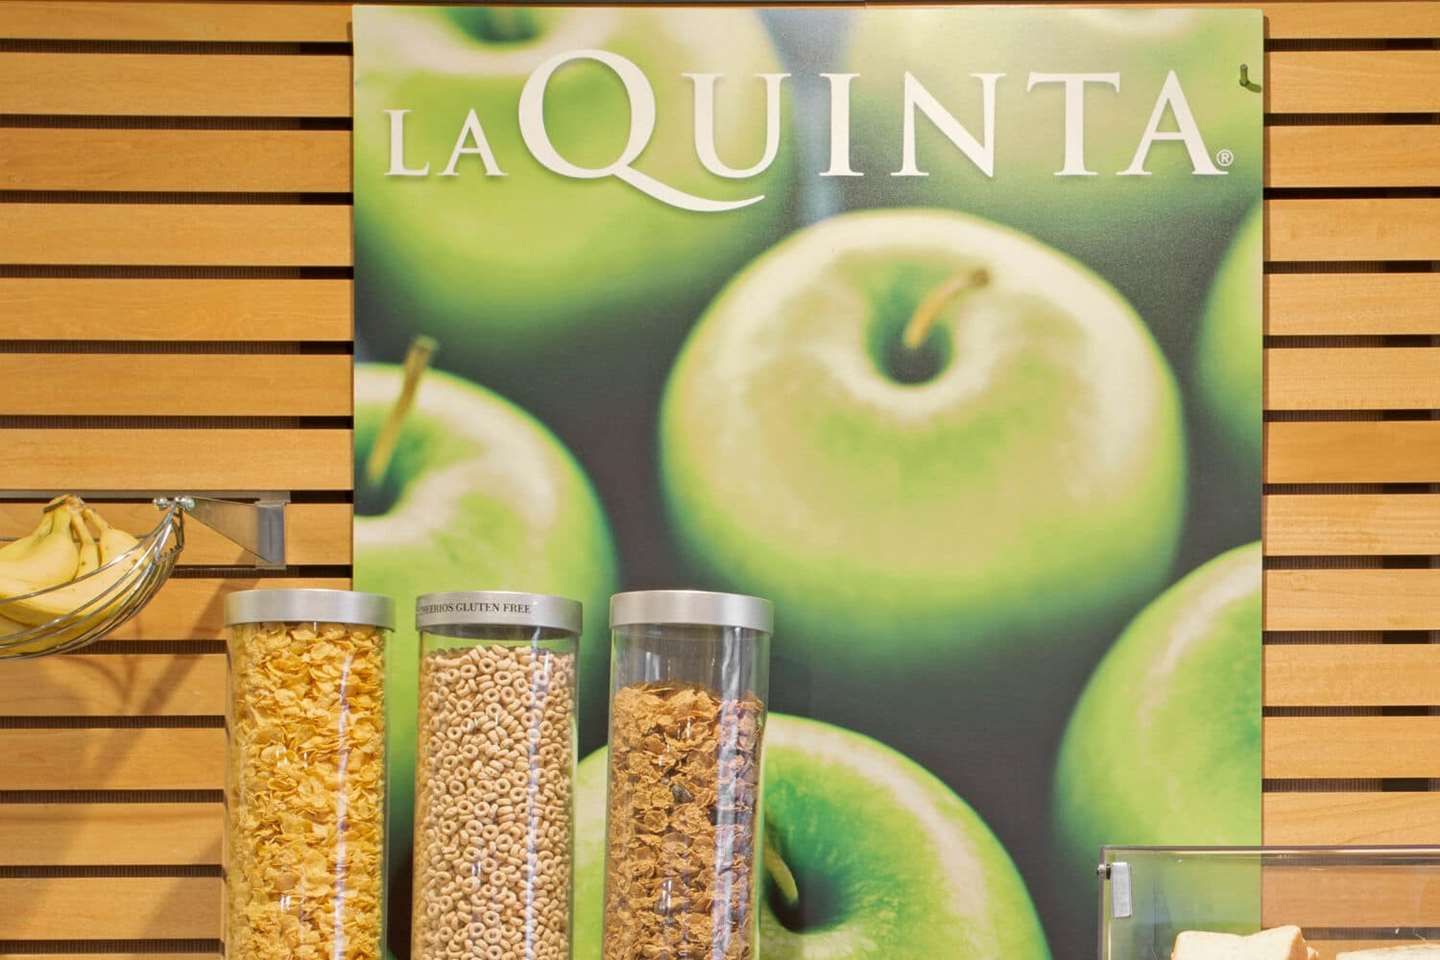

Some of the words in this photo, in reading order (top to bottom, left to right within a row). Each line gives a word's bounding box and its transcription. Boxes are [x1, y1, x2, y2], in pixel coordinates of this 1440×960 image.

[384, 108, 508, 177] LA
[455, 602, 501, 613] GLUTEN
[503, 603, 533, 614] FREE
